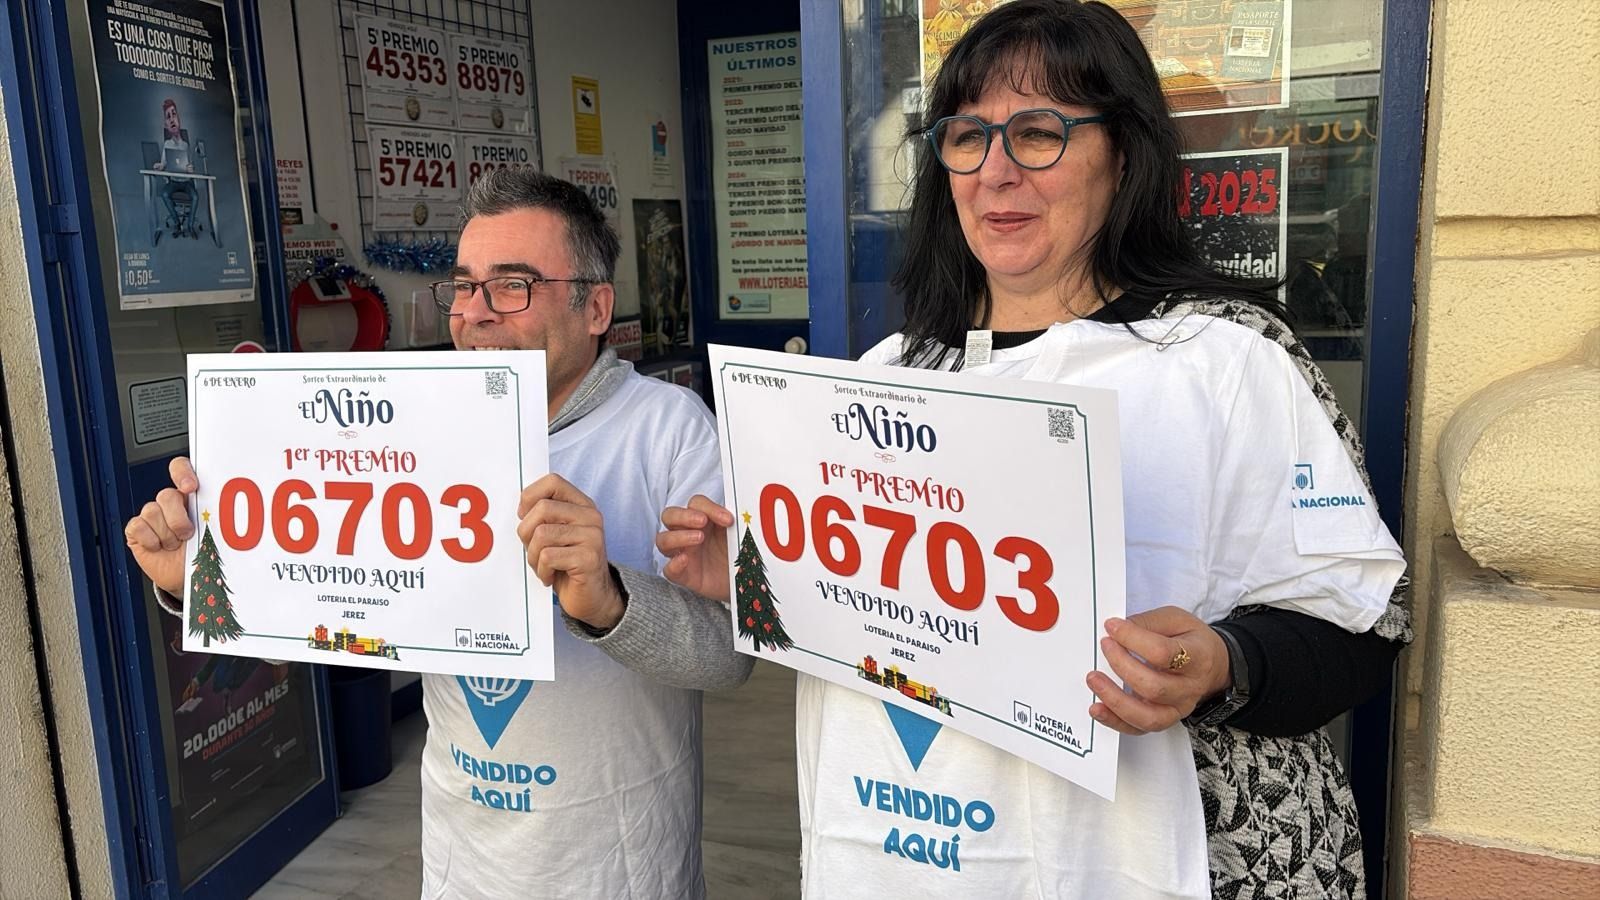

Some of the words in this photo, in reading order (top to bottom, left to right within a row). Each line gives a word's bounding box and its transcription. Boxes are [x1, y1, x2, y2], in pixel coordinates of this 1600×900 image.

[107, 20, 122, 39] ES
[124, 25, 145, 46] UNA
[148, 29, 173, 51] COSA
[175, 35, 192, 56] QUE
[193, 39, 214, 61] PASA
[382, 30, 438, 56] PREMIO
[713, 38, 797, 54] NUESTROS
[176, 55, 192, 75] LOS
[367, 47, 446, 85] 45353
[472, 48, 518, 68] PREMIO
[727, 56, 796, 71] ÚLTIMOS
[458, 62, 524, 95] 88979
[756, 106, 783, 114] PREMIO
[395, 140, 452, 159] PREMIO
[482, 146, 528, 163] PREMIO
[768, 156, 801, 164] PREMIOS
[277, 160, 303, 168] REYES
[380, 157, 456, 188] 57421
[1200, 168, 1278, 215] 2025
[768, 228, 799, 236] LOTERÍA
[204, 377, 208, 386] 6
[209, 377, 222, 386] DE
[223, 377, 256, 388] ENERO
[302, 375, 324, 383] Sorteo
[326, 374, 376, 383] Extraordinario
[732, 372, 737, 382] 6
[738, 373, 752, 384] DE
[753, 374, 787, 389] ENERO
[834, 384, 858, 396] Sorteo
[859, 388, 916, 404] Extraordinario
[917, 395, 927, 405] de
[298, 401, 315, 419] El
[315, 388, 394, 428] Niño
[831, 413, 849, 434] El
[848, 403, 937, 453] Niño
[284, 447, 310, 470] 1er
[315, 446, 416, 475] PREMIO
[819, 461, 846, 485] 1er
[850, 468, 964, 513] PREMIO
[1300, 496, 1365, 508] NACIONAL
[218, 477, 494, 563] 06703
[760, 482, 1060, 632] 06703
[272, 562, 366, 585] VENDIDO
[370, 567, 425, 593] AQUÍ
[318, 595, 347, 603] LOTERIA
[358, 597, 390, 606] PARAISO
[342, 610, 365, 620] JEREZ
[816, 580, 914, 624] VENDIDO
[918, 611, 979, 646] AQUÍ
[475, 632, 510, 641] LOTERÍA
[475, 641, 520, 650] NACIONAL
[864, 623, 895, 640] LOTERIA
[896, 634, 905, 643] EL
[906, 637, 941, 654] PARAISO
[890, 647, 916, 662] JEREZ
[246, 696, 263, 719] AL
[264, 680, 289, 707] MES
[1035, 712, 1073, 735] LOTERÍA
[1034, 723, 1082, 749] NACIONAL
[451, 743, 557, 786] VENDIDO
[472, 785, 531, 812] AQUÍ
[854, 776, 995, 832] VENDIDO
[883, 827, 961, 872] AQUÍ
